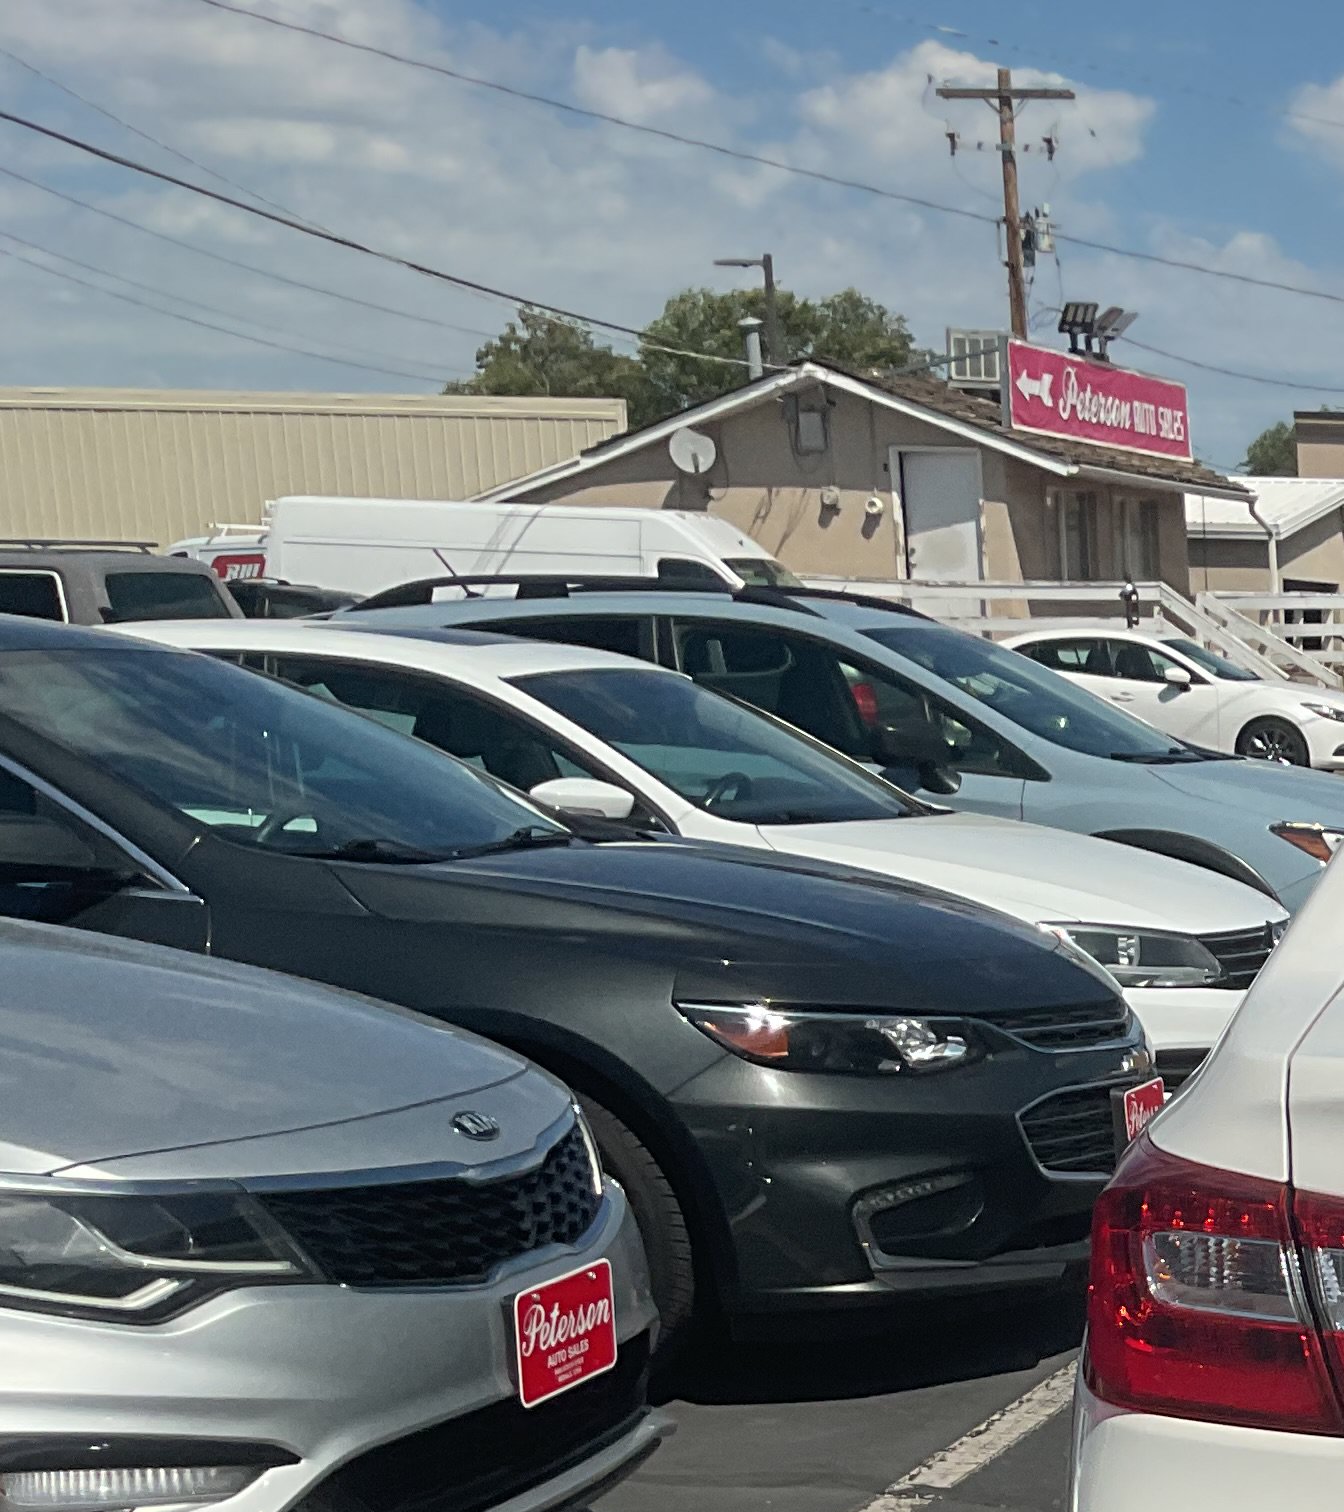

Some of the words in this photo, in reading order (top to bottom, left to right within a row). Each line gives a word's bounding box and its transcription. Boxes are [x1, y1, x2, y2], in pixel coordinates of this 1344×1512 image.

[1059, 366, 1131, 430] Peterson
[1133, 400, 1157, 435] AUTO
[1158, 406, 1185, 441] SALES
[522, 1298, 610, 1357] Peterson
[547, 1349, 567, 1368] AUTO
[568, 1339, 589, 1358] SALES
